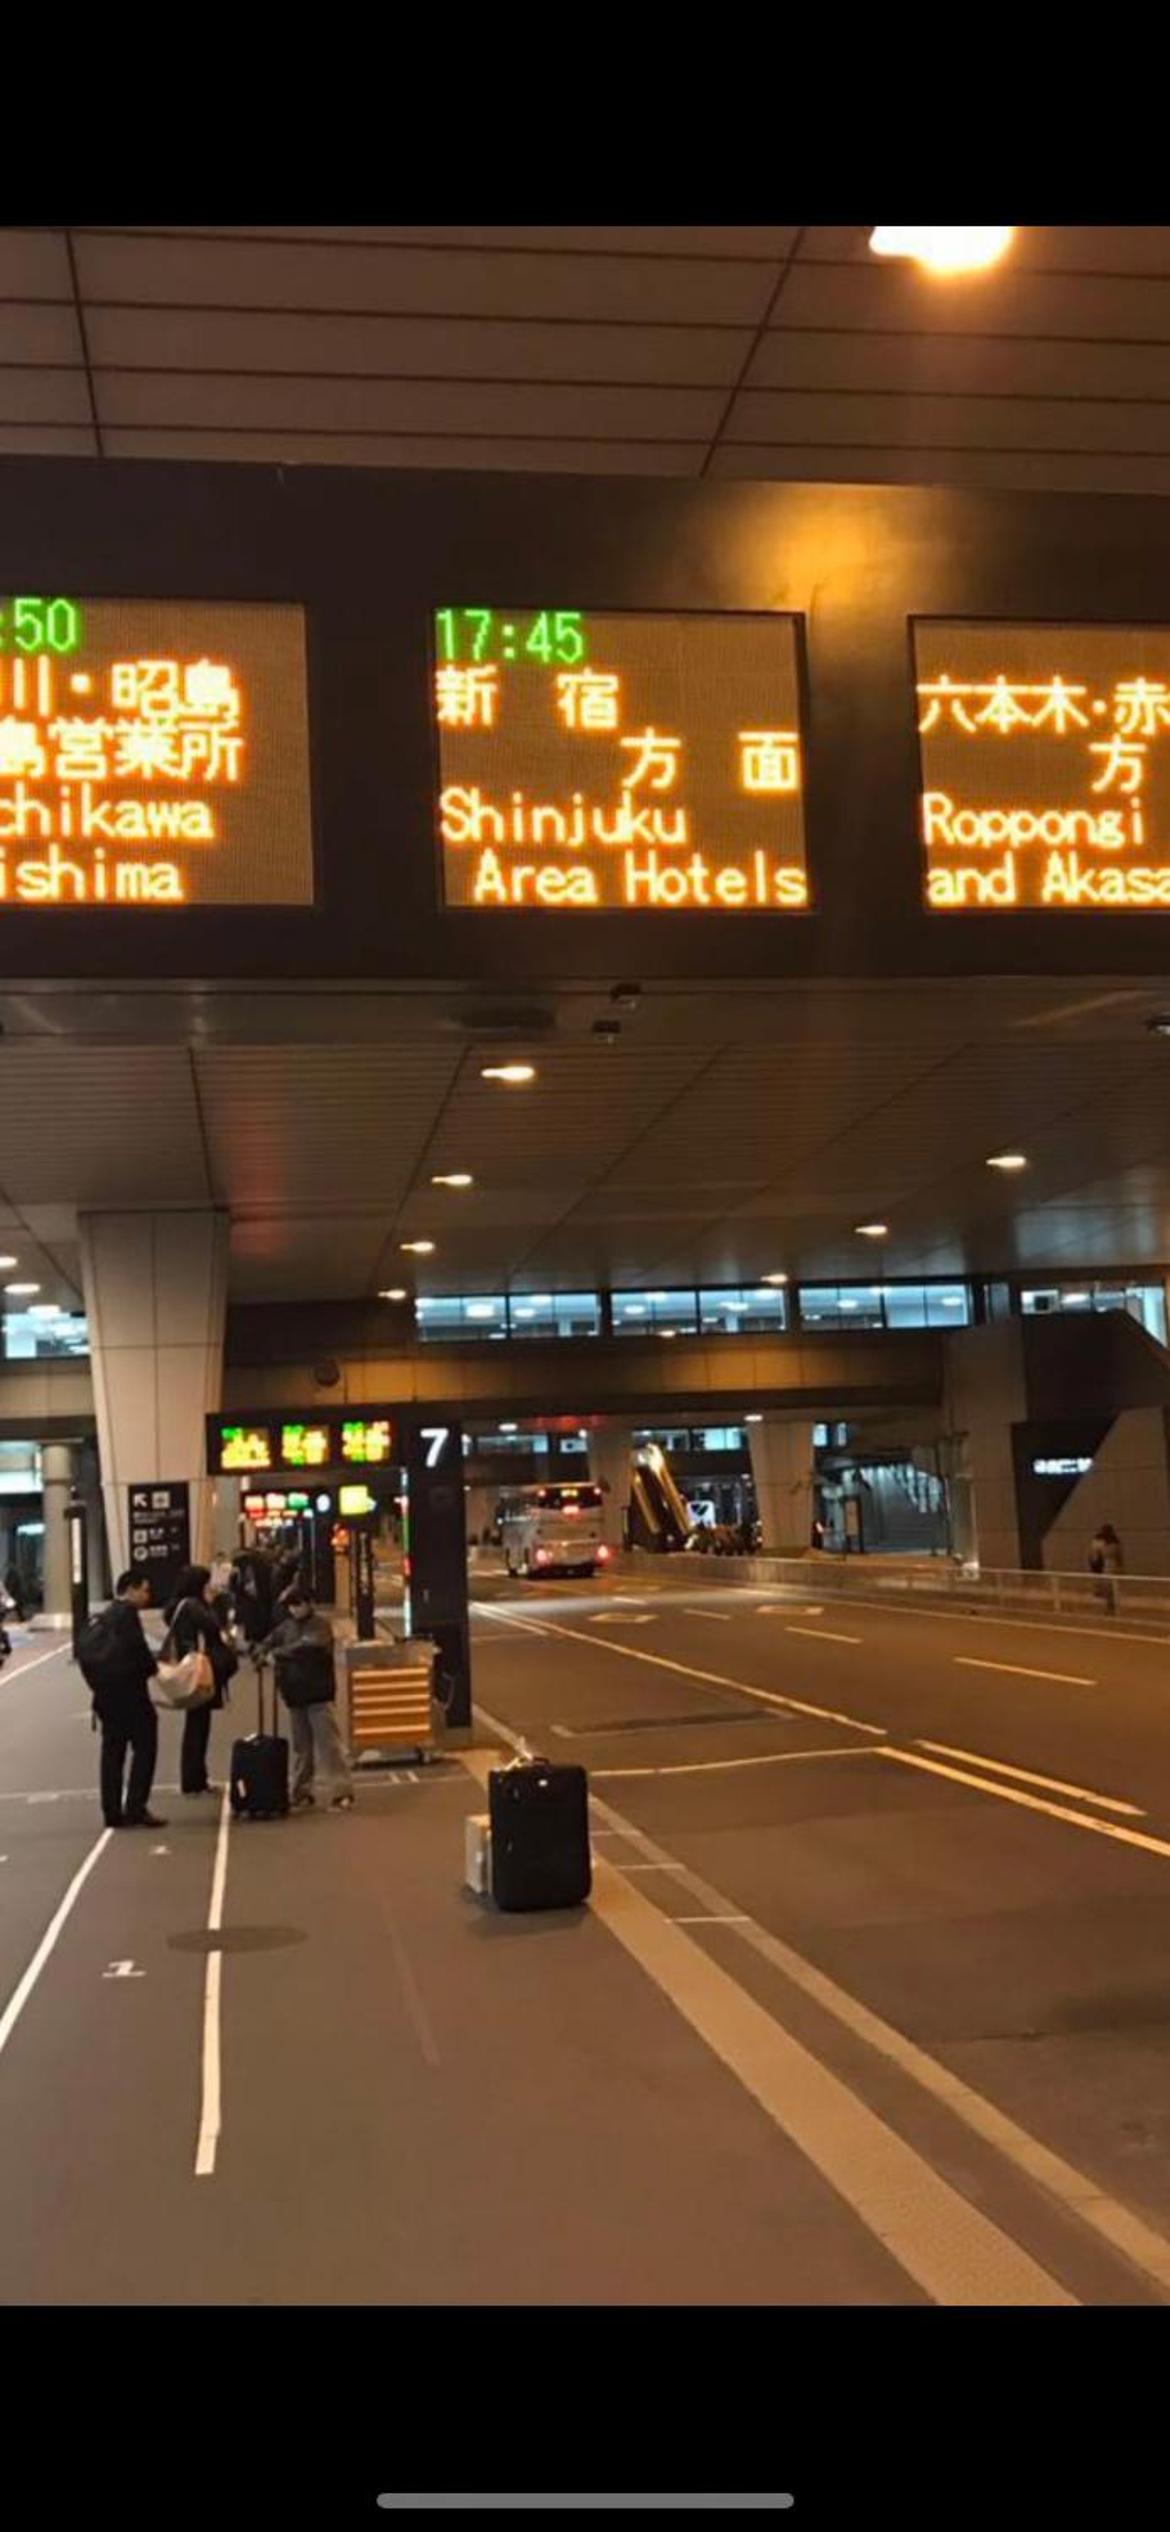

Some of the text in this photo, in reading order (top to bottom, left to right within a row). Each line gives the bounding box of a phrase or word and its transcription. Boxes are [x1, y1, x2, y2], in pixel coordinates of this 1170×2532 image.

[436, 609, 584, 663] 17:45
[1088, 734, 1147, 793] 方
[439, 787, 687, 846] Shinjuku
[923, 792, 1143, 850] Roppongi
[474, 849, 808, 904] Area Hotels
[928, 850, 1016, 905] and
[420, 1428, 449, 1468] 7
